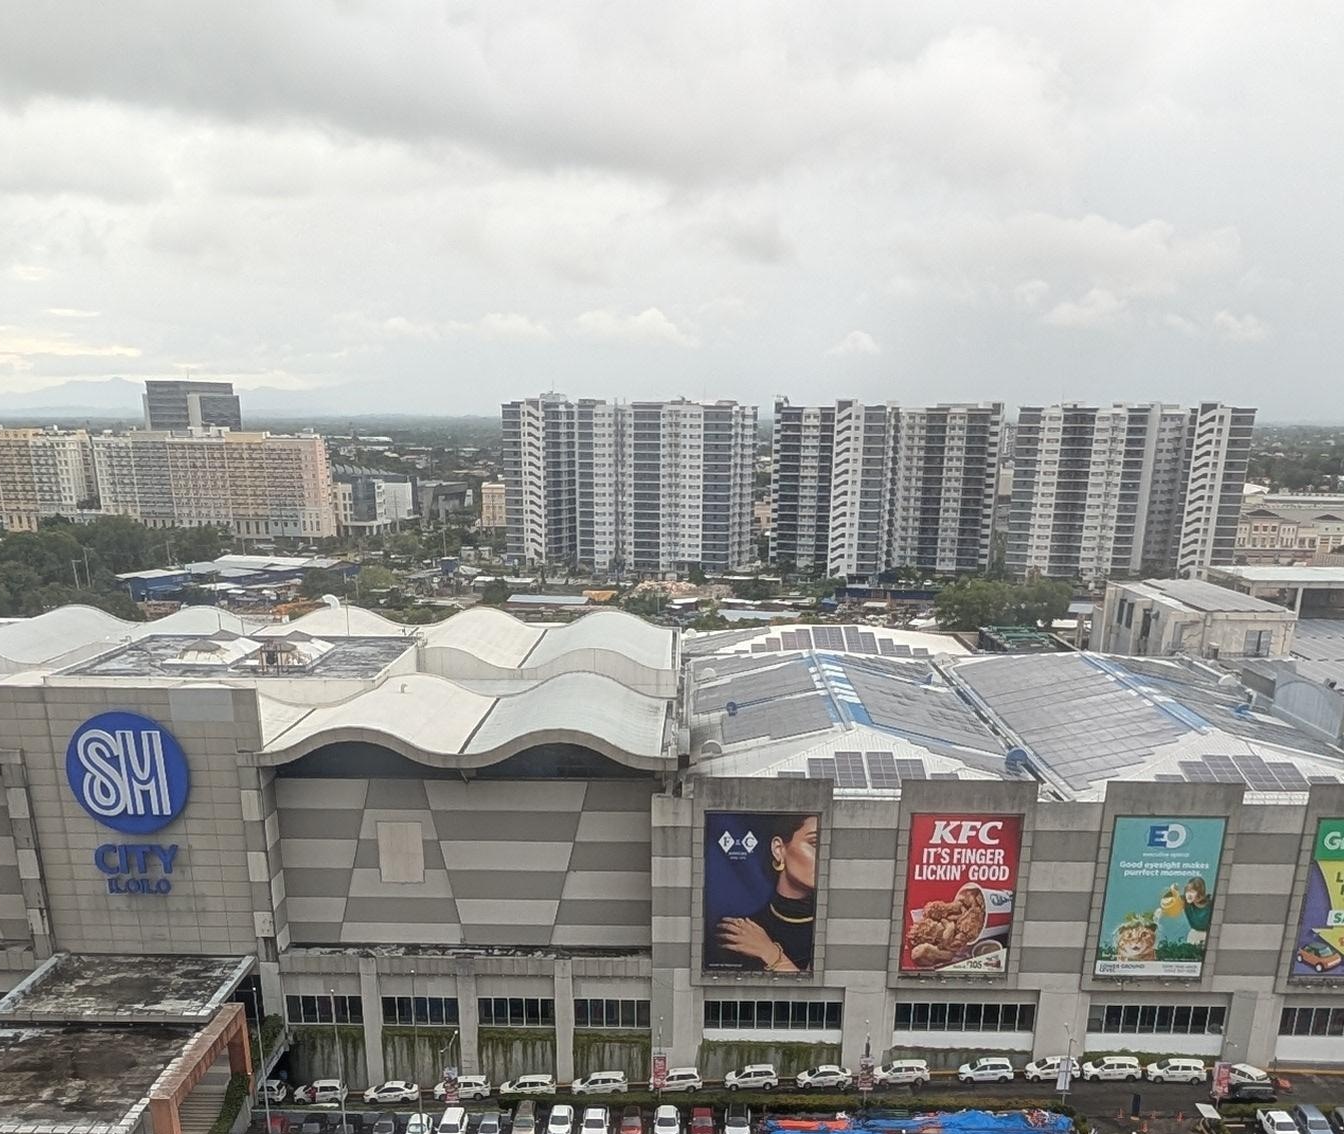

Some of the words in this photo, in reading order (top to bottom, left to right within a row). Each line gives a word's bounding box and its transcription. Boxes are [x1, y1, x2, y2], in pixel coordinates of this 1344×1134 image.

[77, 729, 171, 816] SM
[929, 820, 1003, 845] KFC
[94, 844, 179, 874] CITY
[922, 847, 950, 864] IT'S
[953, 848, 1005, 864] FINGER
[914, 864, 966, 881] LICKIN'
[968, 865, 1010, 881] GOOD
[1144, 861, 1181, 870] eyesight
[1182, 861, 1209, 869] makes
[107, 878, 172, 894] ILOILO
